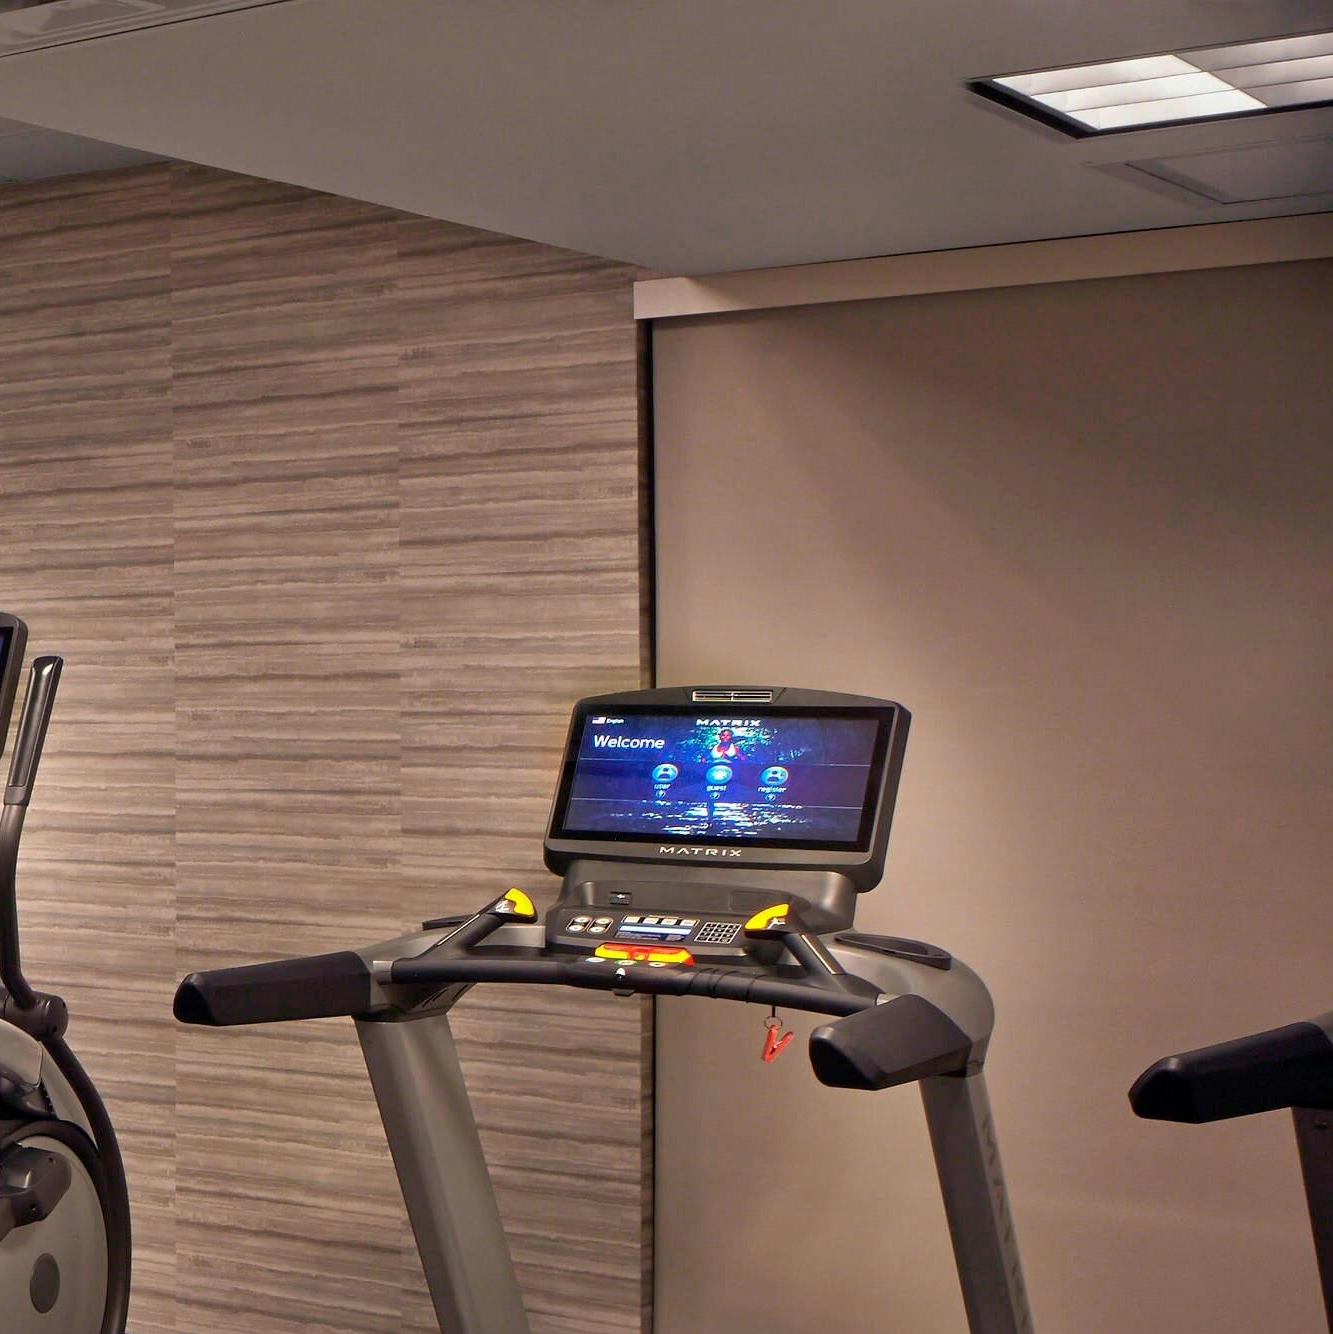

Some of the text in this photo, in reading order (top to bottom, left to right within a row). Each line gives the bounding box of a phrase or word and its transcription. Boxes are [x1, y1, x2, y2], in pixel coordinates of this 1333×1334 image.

[696, 718, 762, 727] MATRIX
[593, 734, 666, 749] Welcome
[659, 846, 742, 857] MATRIX
